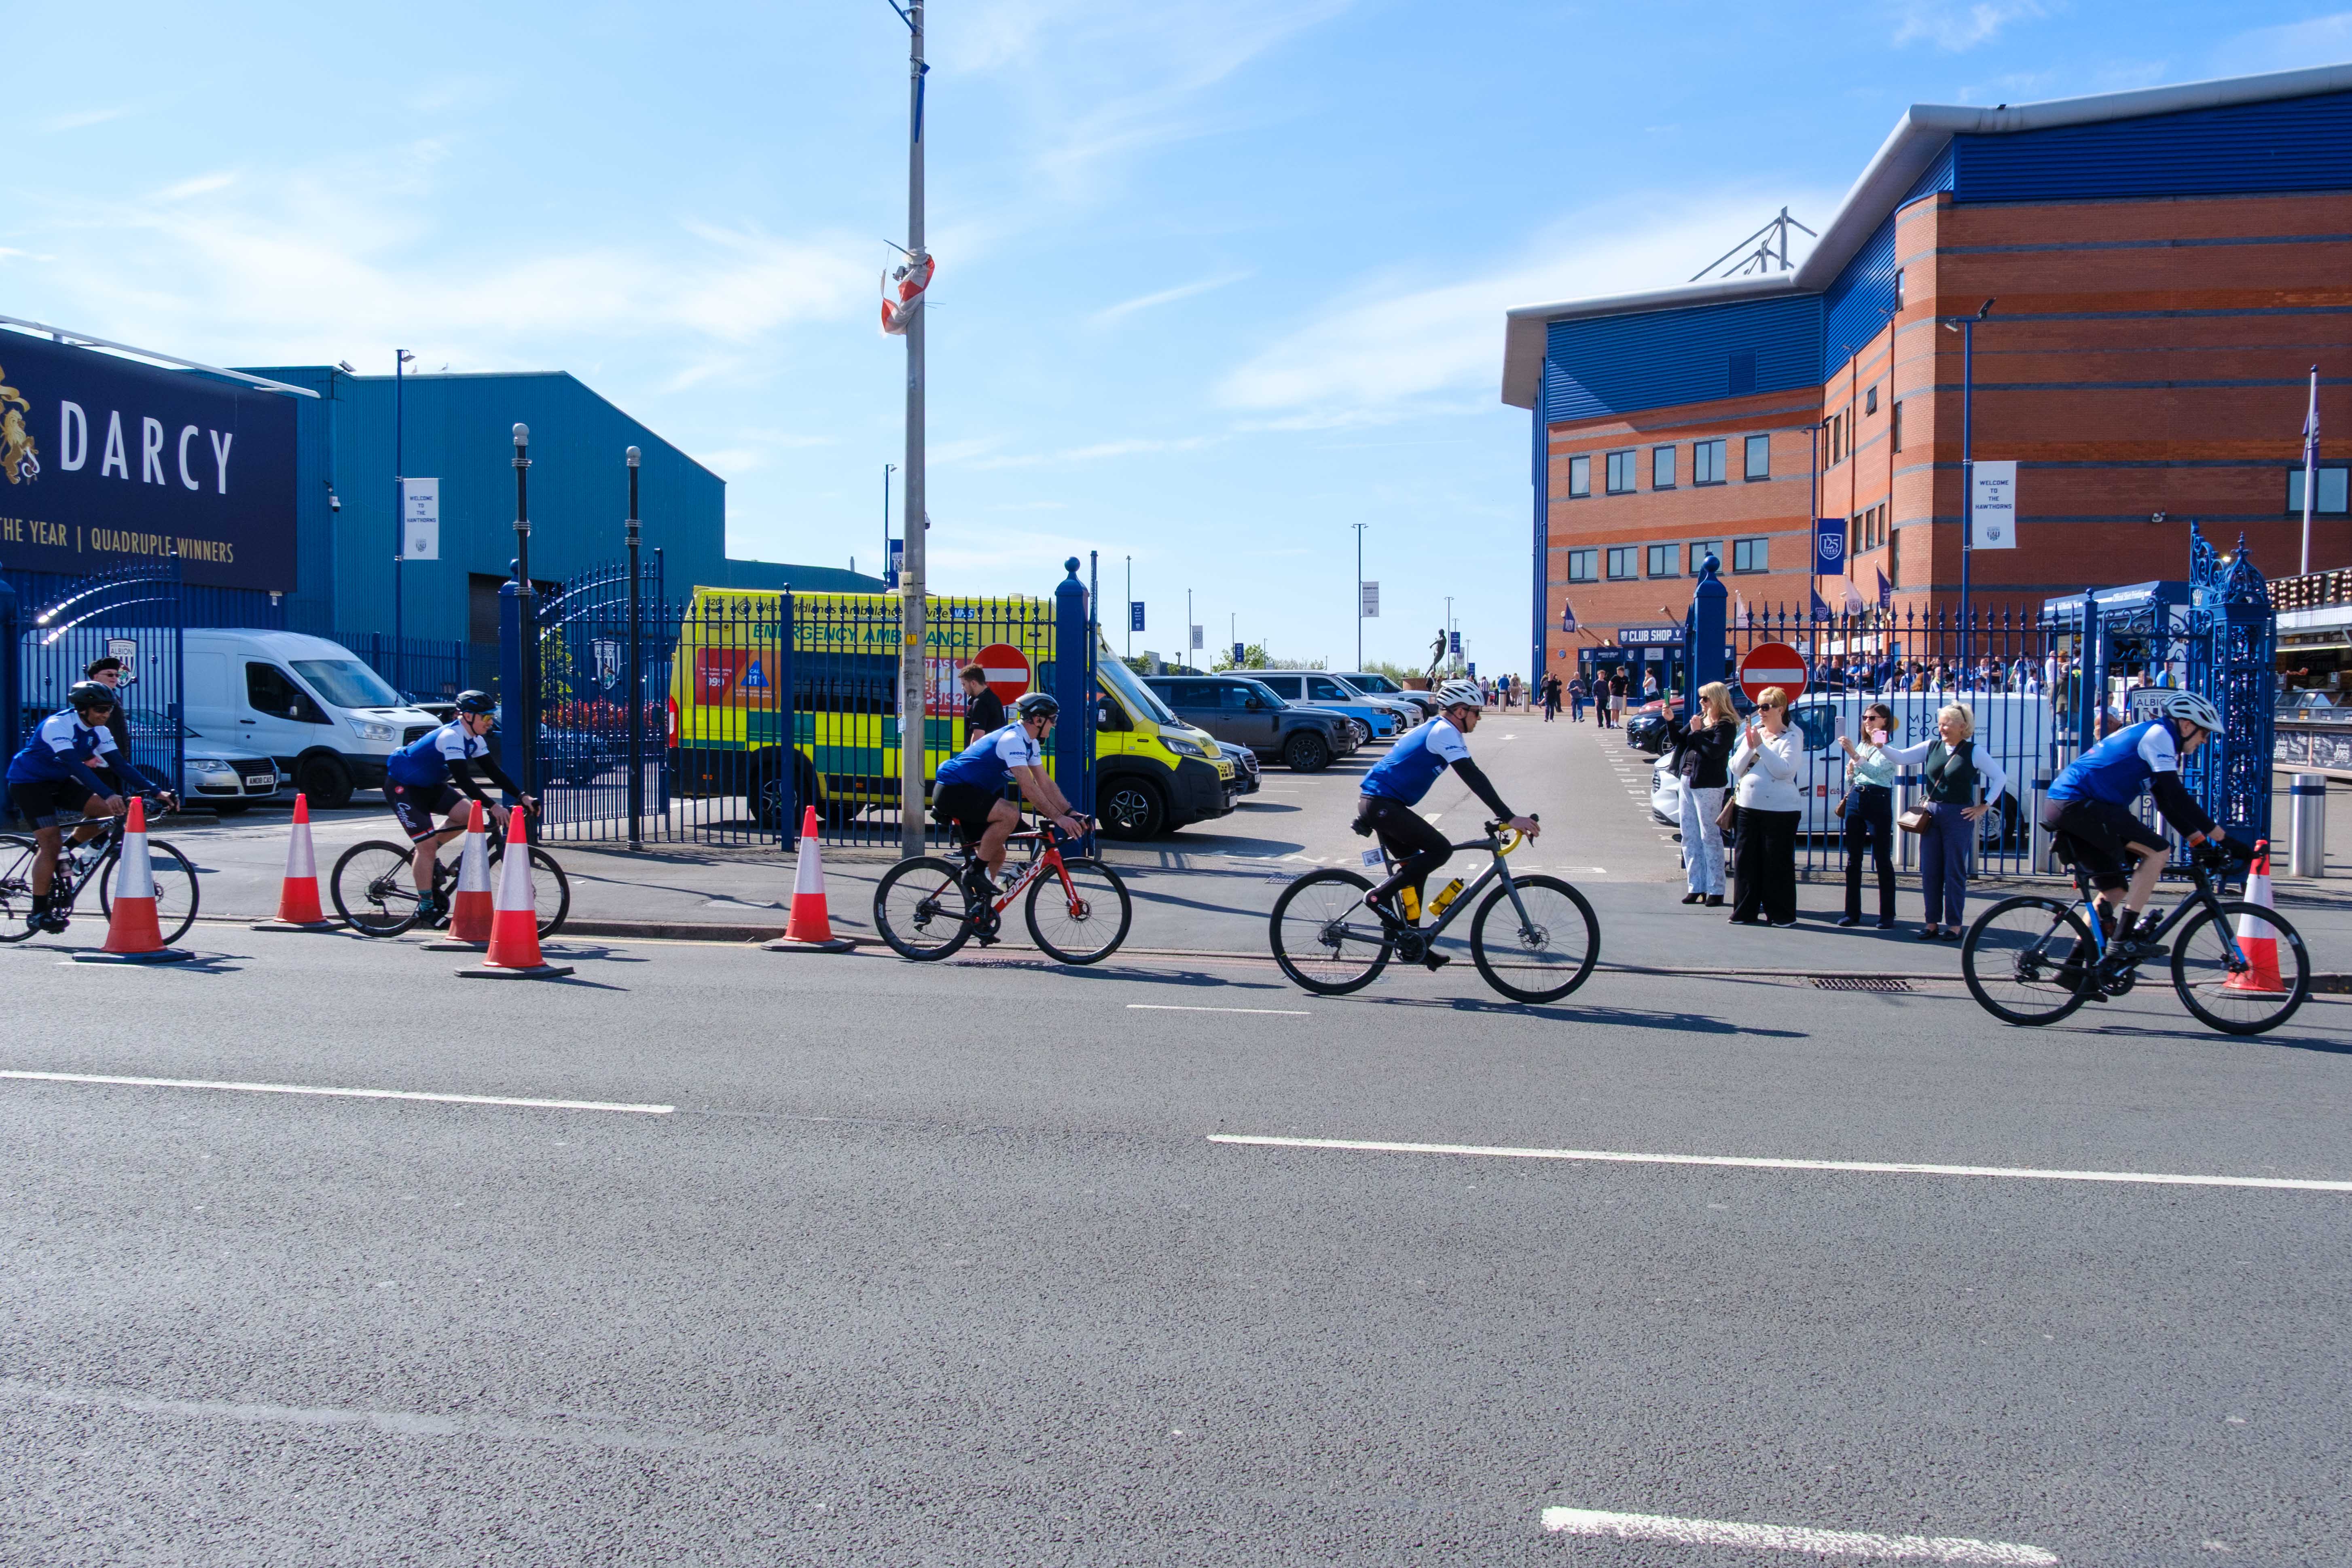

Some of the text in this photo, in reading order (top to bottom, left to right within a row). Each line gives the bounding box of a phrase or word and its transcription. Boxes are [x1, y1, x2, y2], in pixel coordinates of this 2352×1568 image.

[61, 400, 233, 494] DARCY
[29, 521, 67, 546] YEAR
[91, 528, 172, 557] QUADRUPLE
[177, 537, 234, 563] WINNERS
[753, 624, 974, 646] EMRGENCY AMBANCE
[1629, 630, 1672, 642] CLUB SHOP
[925, 692, 963, 705] PSIS?
[1909, 713, 1938, 724] MOL
[1909, 727, 1940, 737] COO
[1003, 856, 1045, 904] RIDLEY
